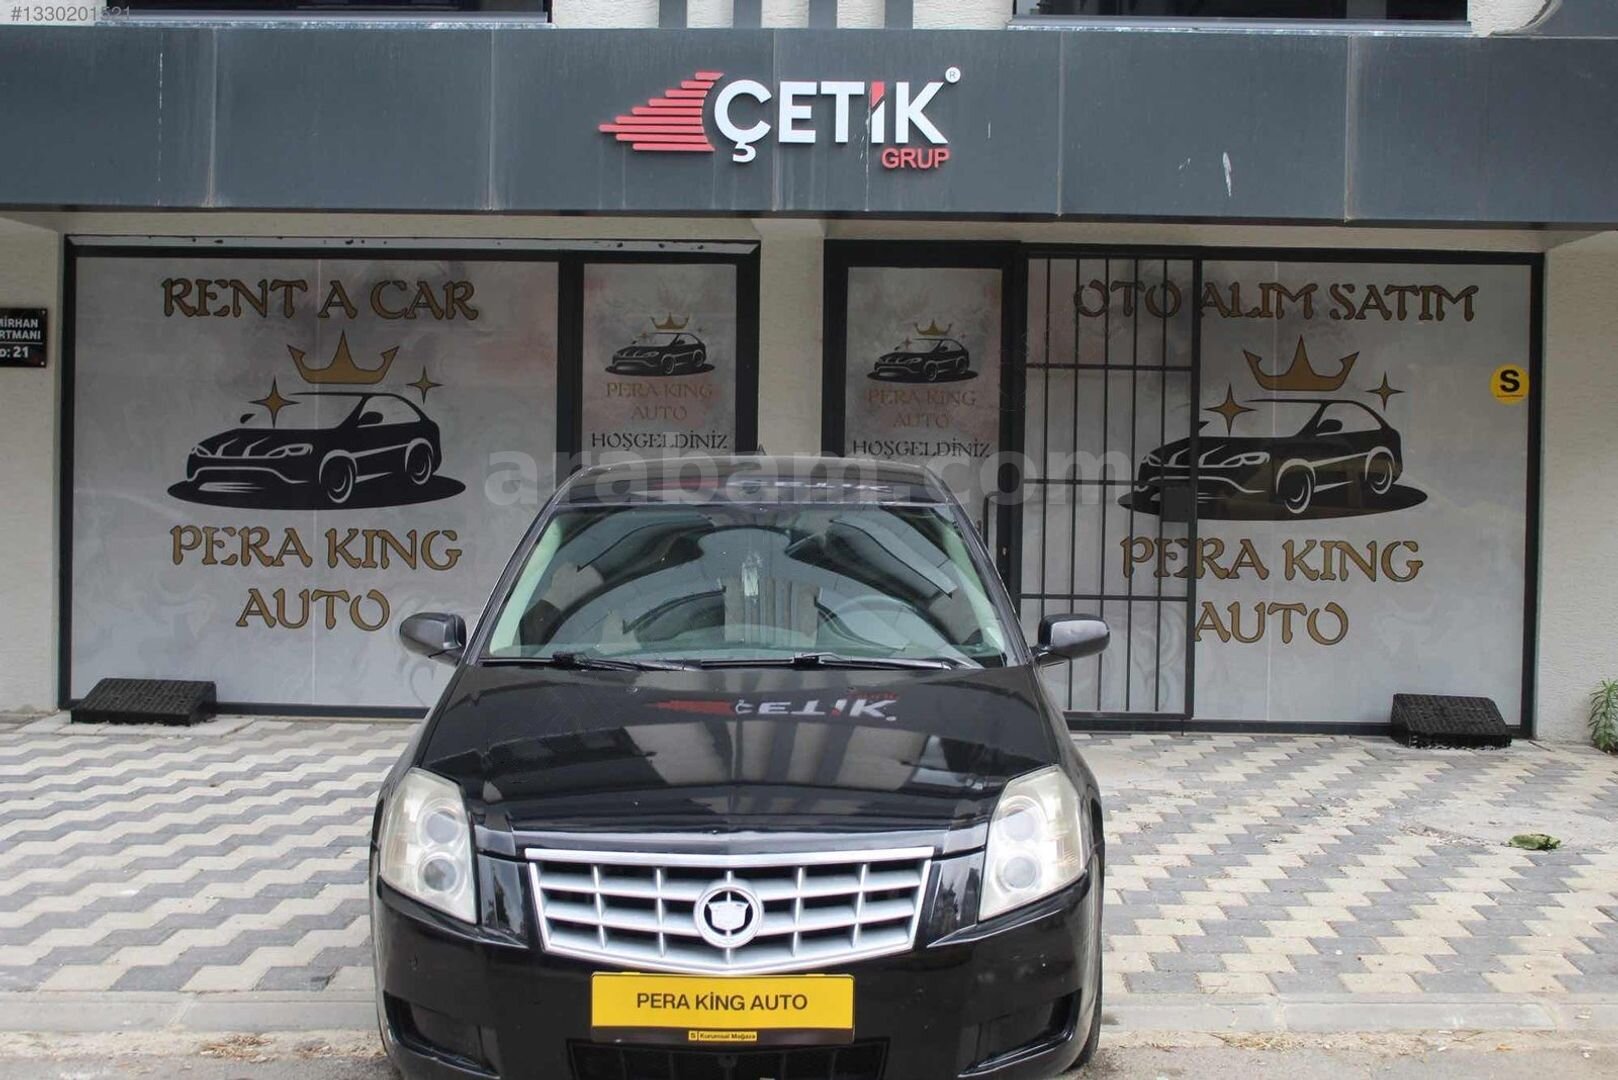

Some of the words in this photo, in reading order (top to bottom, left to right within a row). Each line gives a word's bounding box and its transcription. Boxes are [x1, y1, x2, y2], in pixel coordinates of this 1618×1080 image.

[881, 147, 951, 169] GRUP
[161, 278, 308, 318] RENT
[317, 280, 358, 320] A
[370, 280, 479, 320] CAR
[1073, 279, 1182, 318] OTO
[1199, 281, 1319, 318] ALIM
[1329, 283, 1480, 322] SATIM
[13, 346, 29, 358] 21
[1500, 369, 1520, 393] S
[631, 405, 688, 422] AUTO
[170, 525, 313, 568] PERA
[325, 528, 463, 571] KING
[1120, 536, 1269, 581] PERA
[1282, 539, 1424, 583] KING
[235, 588, 391, 632] AUTO
[1195, 601, 1349, 646] AUTO
[636, 992, 691, 1010] PERA
[695, 991, 746, 1011] KİNG
[749, 994, 808, 1011] AUTO
